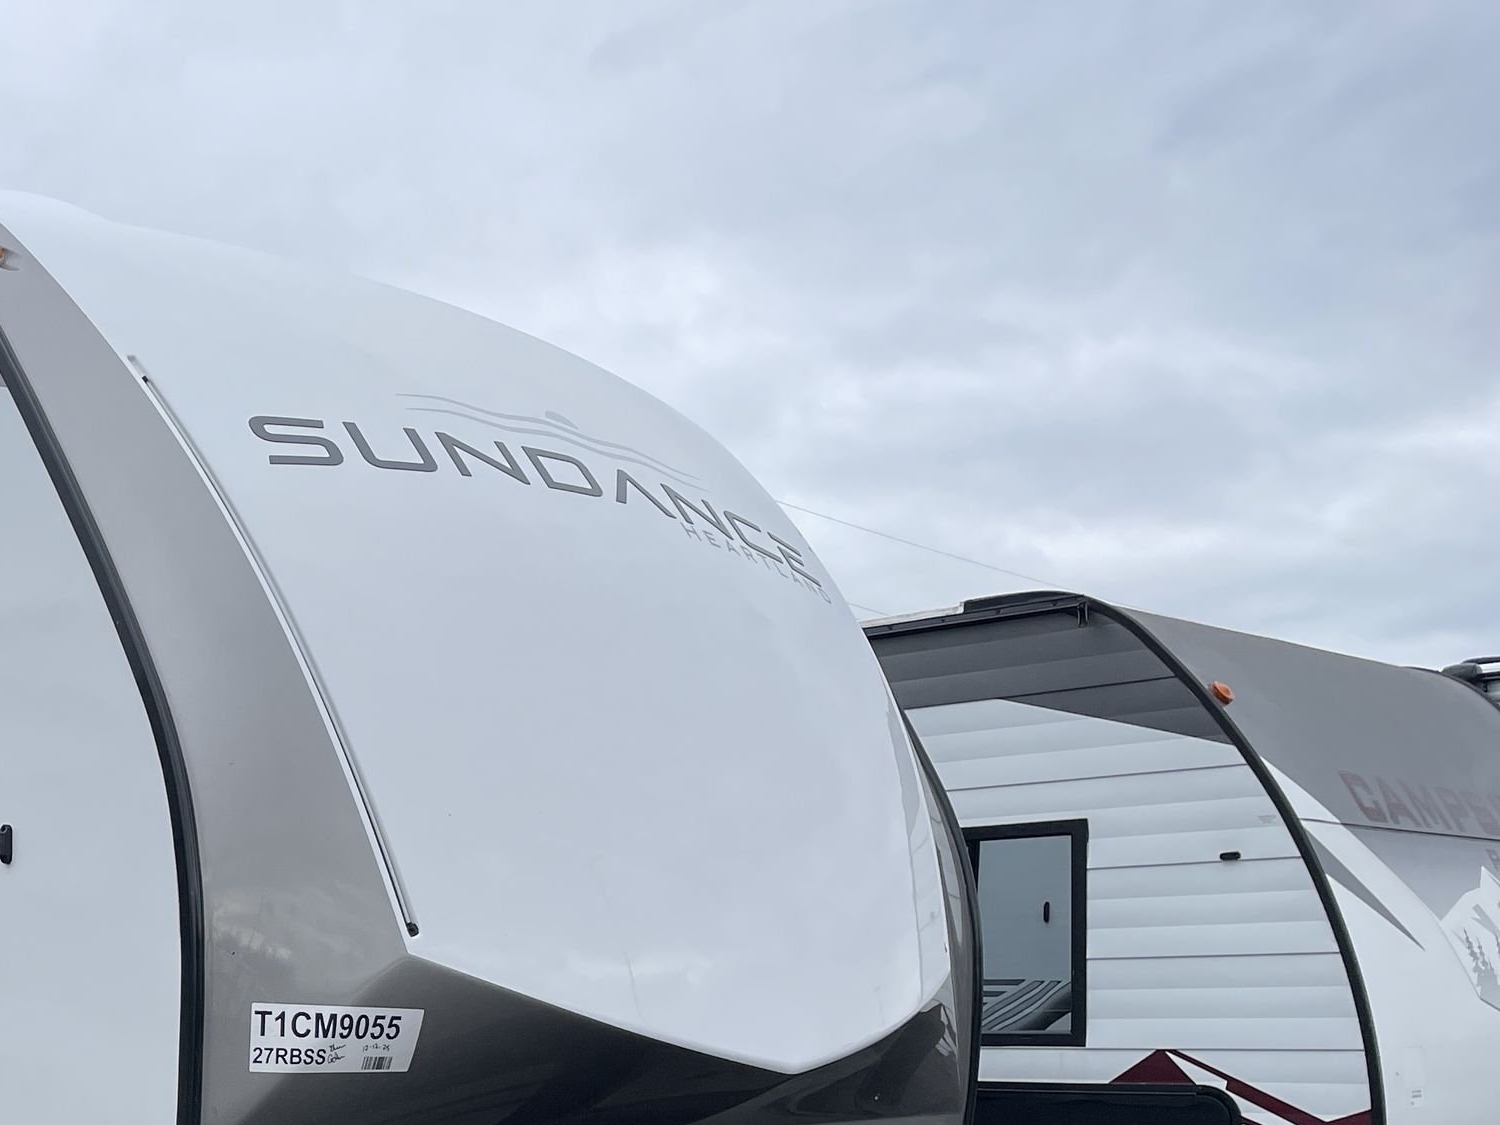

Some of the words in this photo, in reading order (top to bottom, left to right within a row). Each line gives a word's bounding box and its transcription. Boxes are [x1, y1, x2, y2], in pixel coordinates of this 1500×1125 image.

[248, 414, 822, 588] SUNDANCE
[680, 521, 833, 604] HEARTLAND
[254, 1010, 402, 1040] T1CM9055
[252, 1047, 326, 1065] 27RBSS
